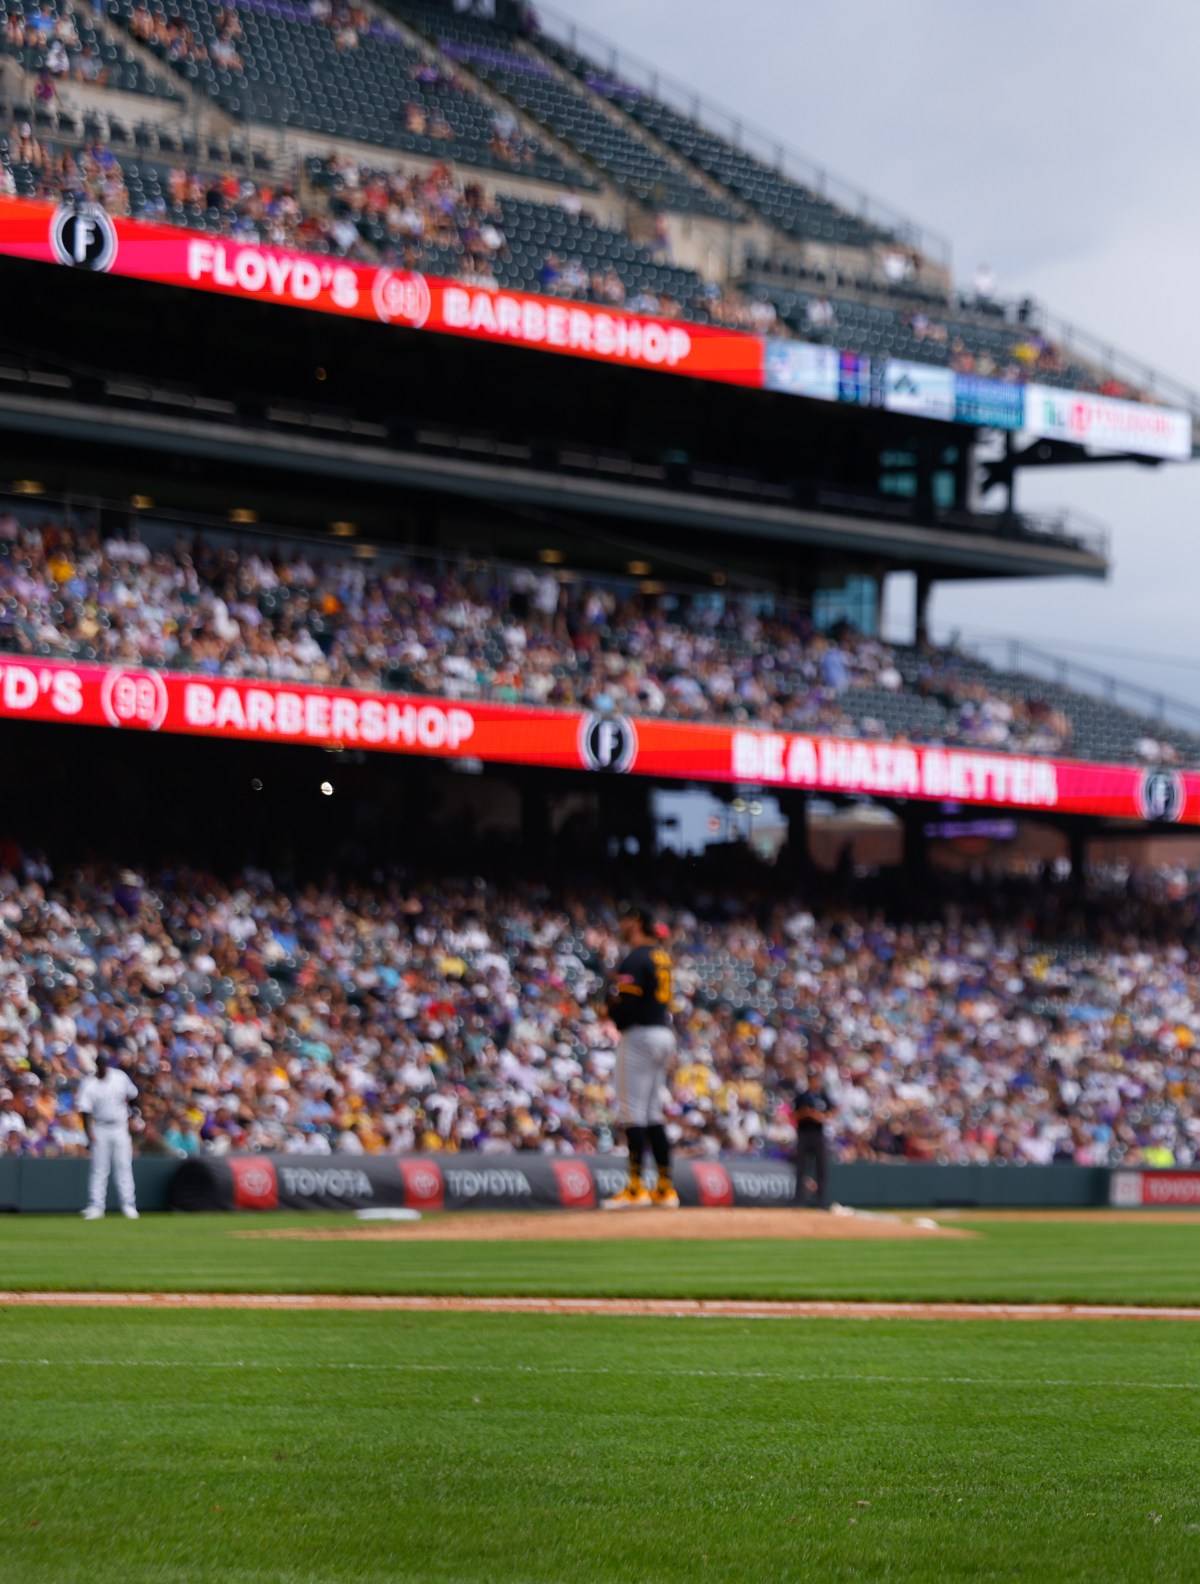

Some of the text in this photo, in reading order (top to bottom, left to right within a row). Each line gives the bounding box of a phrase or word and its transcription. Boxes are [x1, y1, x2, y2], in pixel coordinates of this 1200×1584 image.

[187, 238, 359, 308] FLOYD'S
[443, 287, 691, 366] BARBERSHOP
[0, 664, 83, 715] D'S
[184, 682, 475, 750] BARBERSHOP
[280, 1167, 374, 1197] TOYOTA
[445, 1168, 532, 1197] TOYOTA
